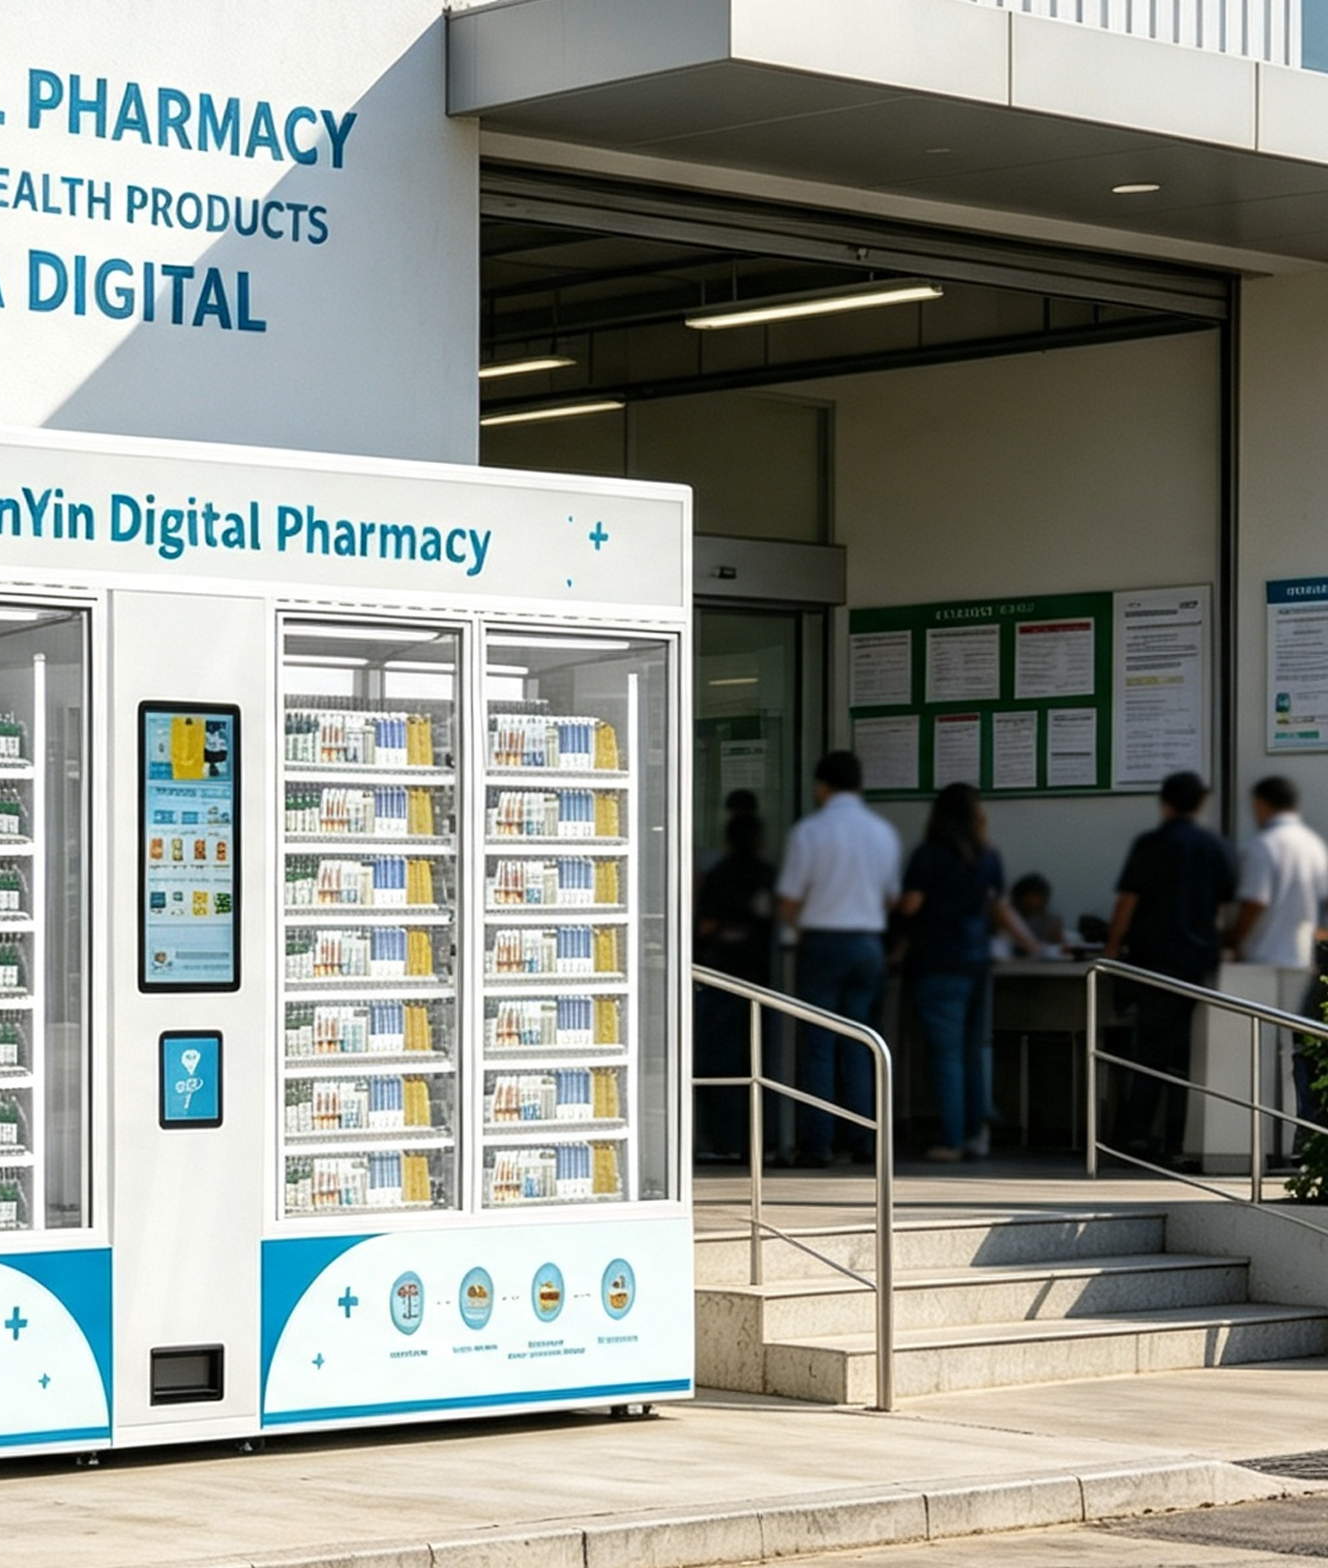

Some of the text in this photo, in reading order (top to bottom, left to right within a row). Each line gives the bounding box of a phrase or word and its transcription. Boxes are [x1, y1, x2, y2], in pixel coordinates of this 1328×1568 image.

[27, 68, 358, 171] PHARMACY
[126, 184, 330, 246] PRODUCTS
[27, 248, 269, 334] DIGITAL
[109, 492, 261, 561] Digital
[276, 503, 492, 577] Pharmacy
